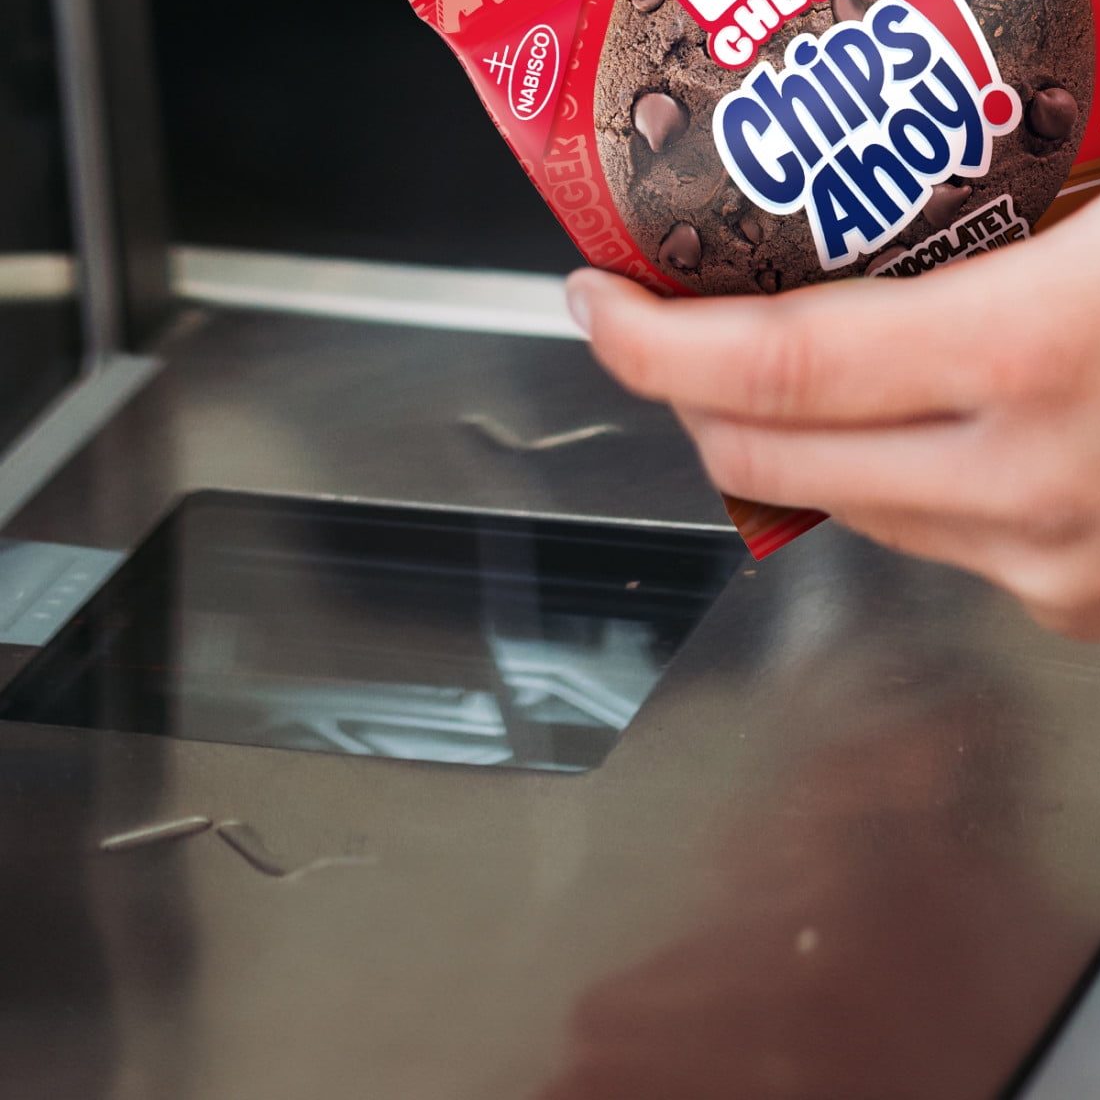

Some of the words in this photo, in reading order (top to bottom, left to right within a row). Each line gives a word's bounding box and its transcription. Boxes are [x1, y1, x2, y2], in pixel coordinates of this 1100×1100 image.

[516, 31, 550, 114] NABISCO
[722, 4, 932, 205] Chips
[544, 134, 634, 266] BIGGER
